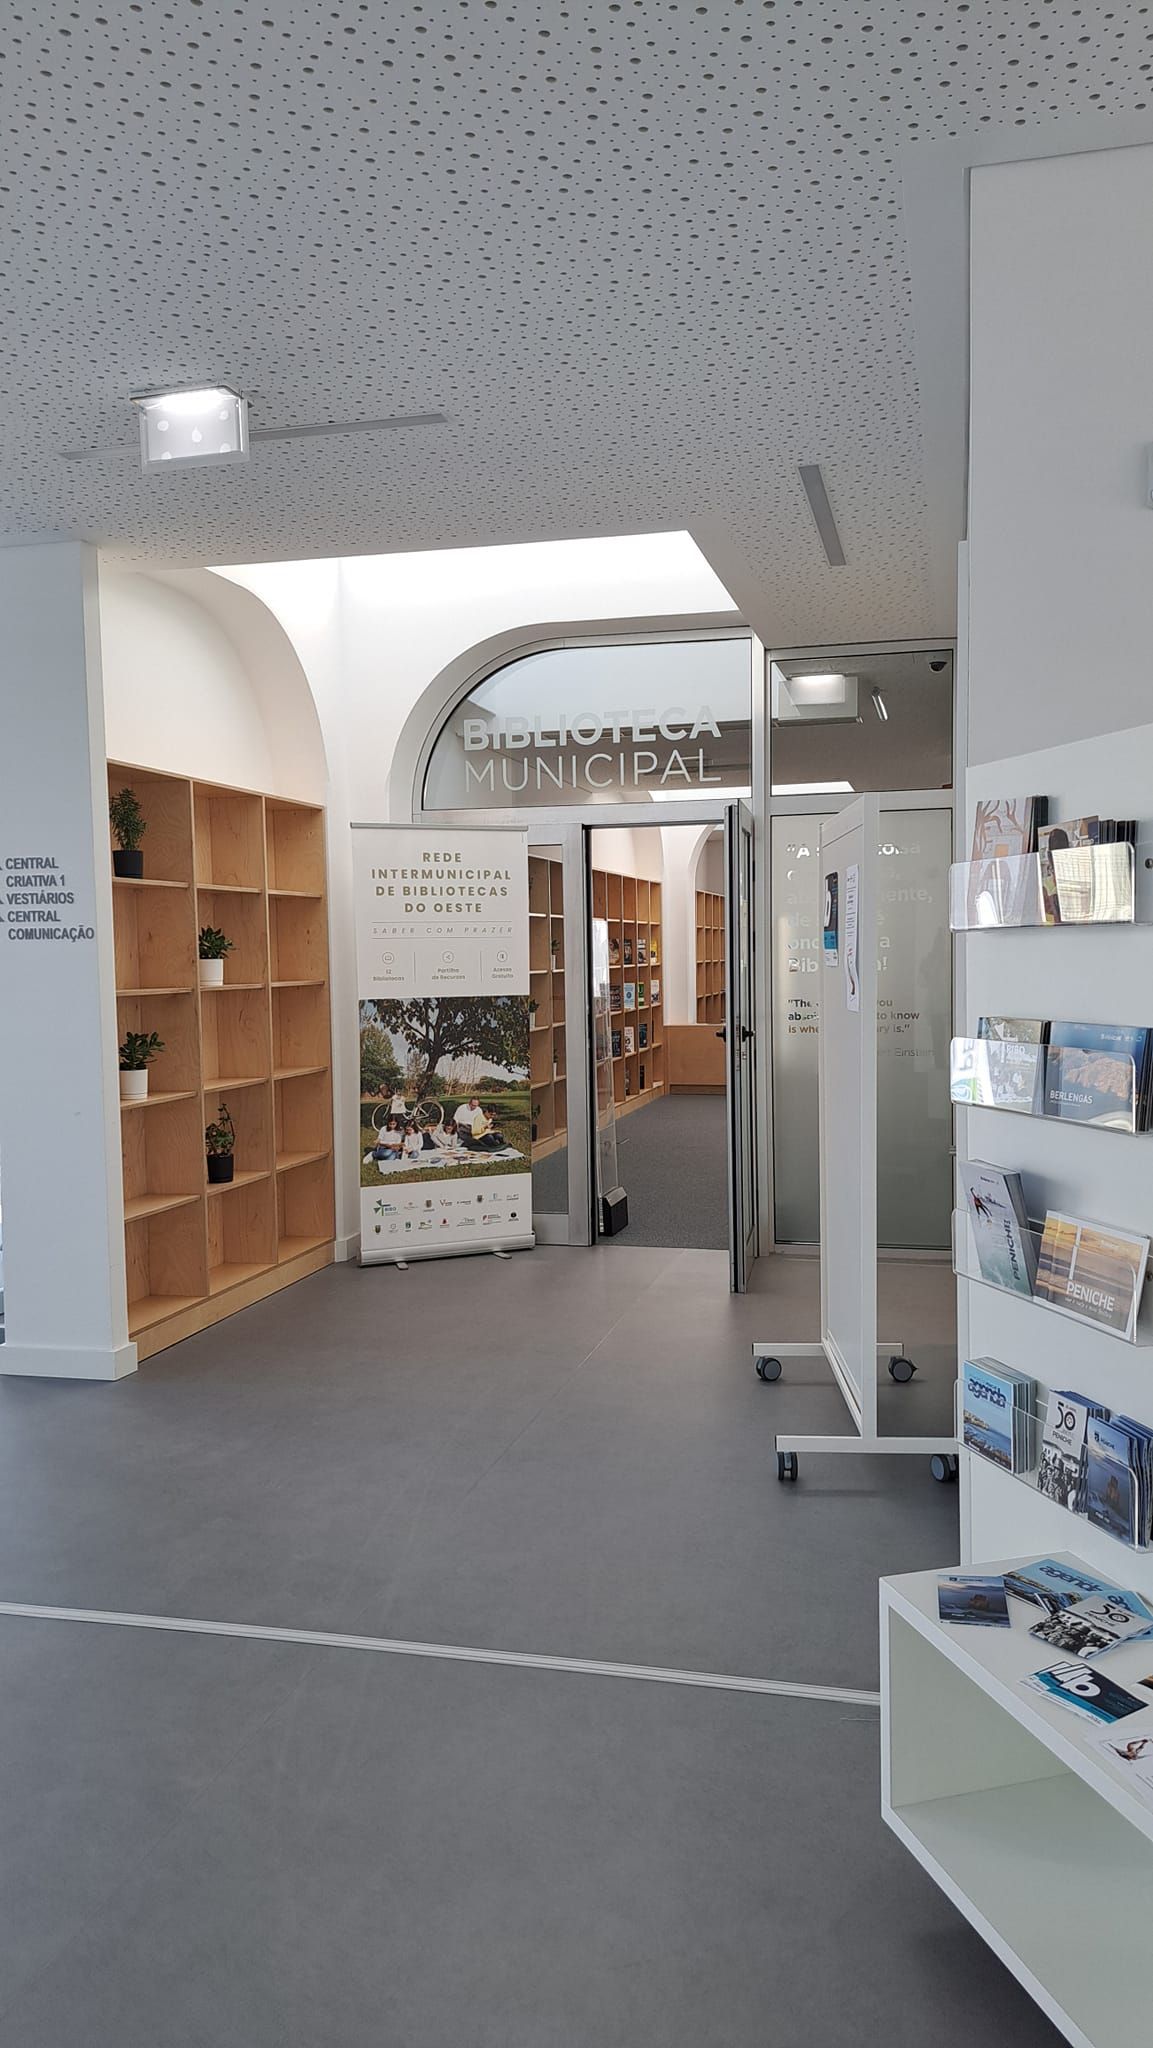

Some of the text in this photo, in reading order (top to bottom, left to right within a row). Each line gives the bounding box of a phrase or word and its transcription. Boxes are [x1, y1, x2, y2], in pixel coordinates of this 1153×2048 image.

[463, 705, 722, 751] BIBLIOTECA
[465, 748, 721, 793] MUNICIPAL
[5, 857, 59, 870] CENTRAL
[422, 852, 462, 863] REDE
[6, 874, 65, 887] CRIATIVA 1
[371, 869, 511, 880] INTERMUNICIPAL
[6, 889, 75, 905] VESTIÁRIOS
[375, 886, 508, 896] DE BIBLIOTECAS
[404, 903, 482, 913] DO OESTE
[7, 910, 61, 922] CENTRAL
[8, 925, 95, 942] COMUNICAÇÃO
[890, 1011, 920, 1020] know
[788, 1025, 797, 1034] is
[1050, 1089, 1093, 1104] BERLENGAS
[1003, 1219, 1021, 1281] PENICHE
[1066, 1281, 1115, 1312] PENICHE
[1055, 1401, 1076, 1431] 50
[1089, 1603, 1131, 1623] 50
